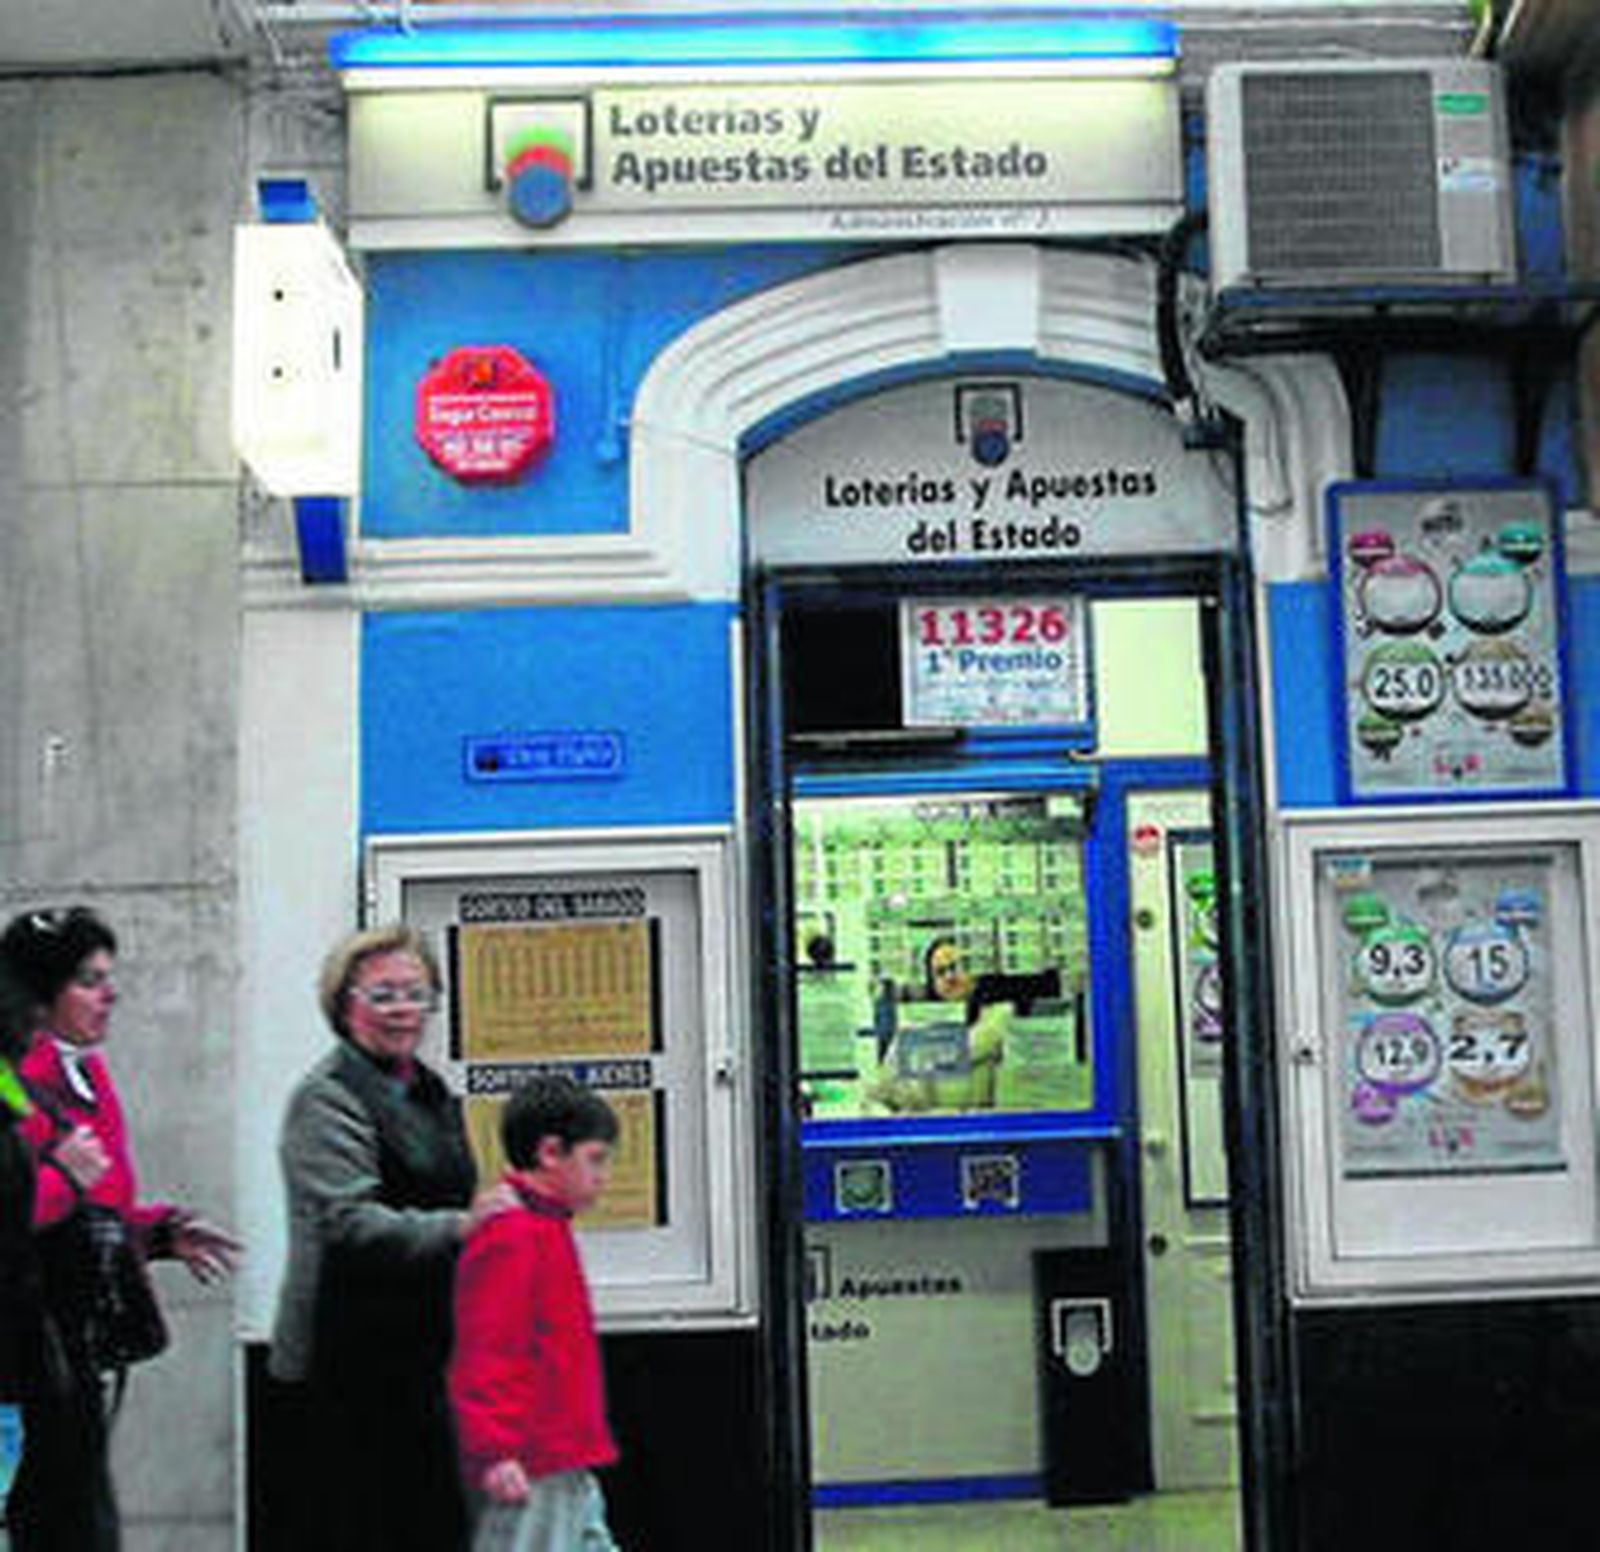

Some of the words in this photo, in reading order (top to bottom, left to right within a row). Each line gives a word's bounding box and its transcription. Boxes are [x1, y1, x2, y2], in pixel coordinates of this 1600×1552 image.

[799, 106, 821, 142] y
[612, 147, 810, 190] Apuestas
[825, 144, 887, 180] del
[900, 144, 1048, 180] Estado
[972, 478, 991, 509] y
[1005, 470, 1158, 507] Apuestas
[907, 520, 958, 553] del
[972, 518, 1081, 551] Estado
[919, 607, 1068, 647] 11326
[959, 649, 1062, 673] Premio
[838, 1276, 962, 1299] Apuestas
